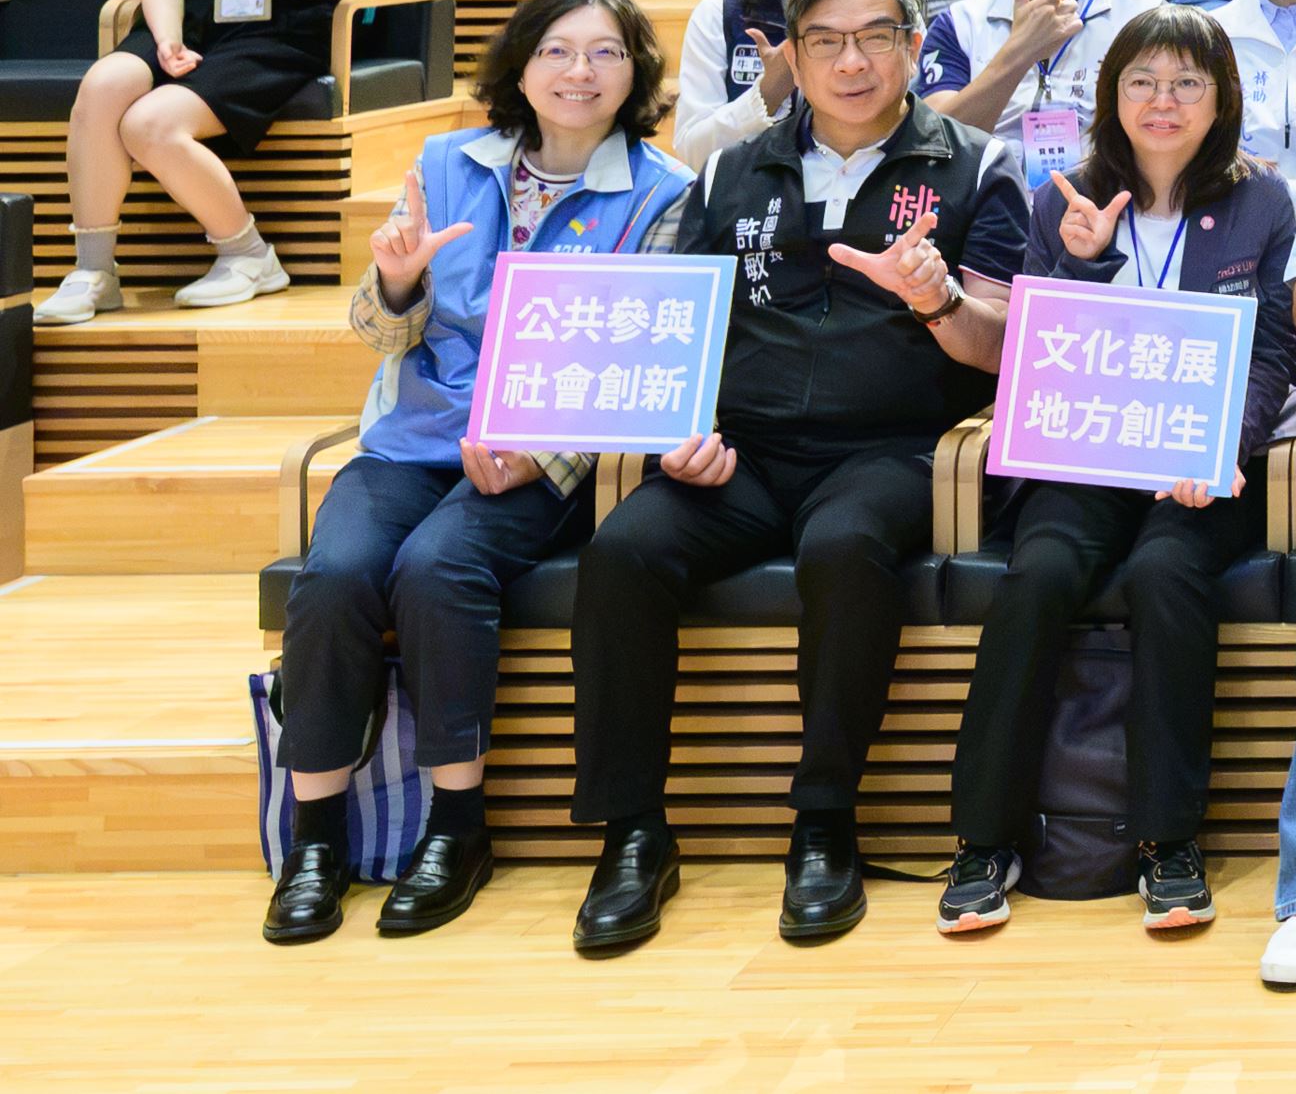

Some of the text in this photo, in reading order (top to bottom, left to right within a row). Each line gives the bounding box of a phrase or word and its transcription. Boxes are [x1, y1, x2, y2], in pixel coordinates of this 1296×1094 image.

[759, 196, 784, 263] 桃園區長
[514, 296, 696, 345] 公共參與
[1032, 323, 1219, 387] 文化發展
[502, 361, 688, 414] 社會創新
[1023, 389, 1209, 454] 地方創生
